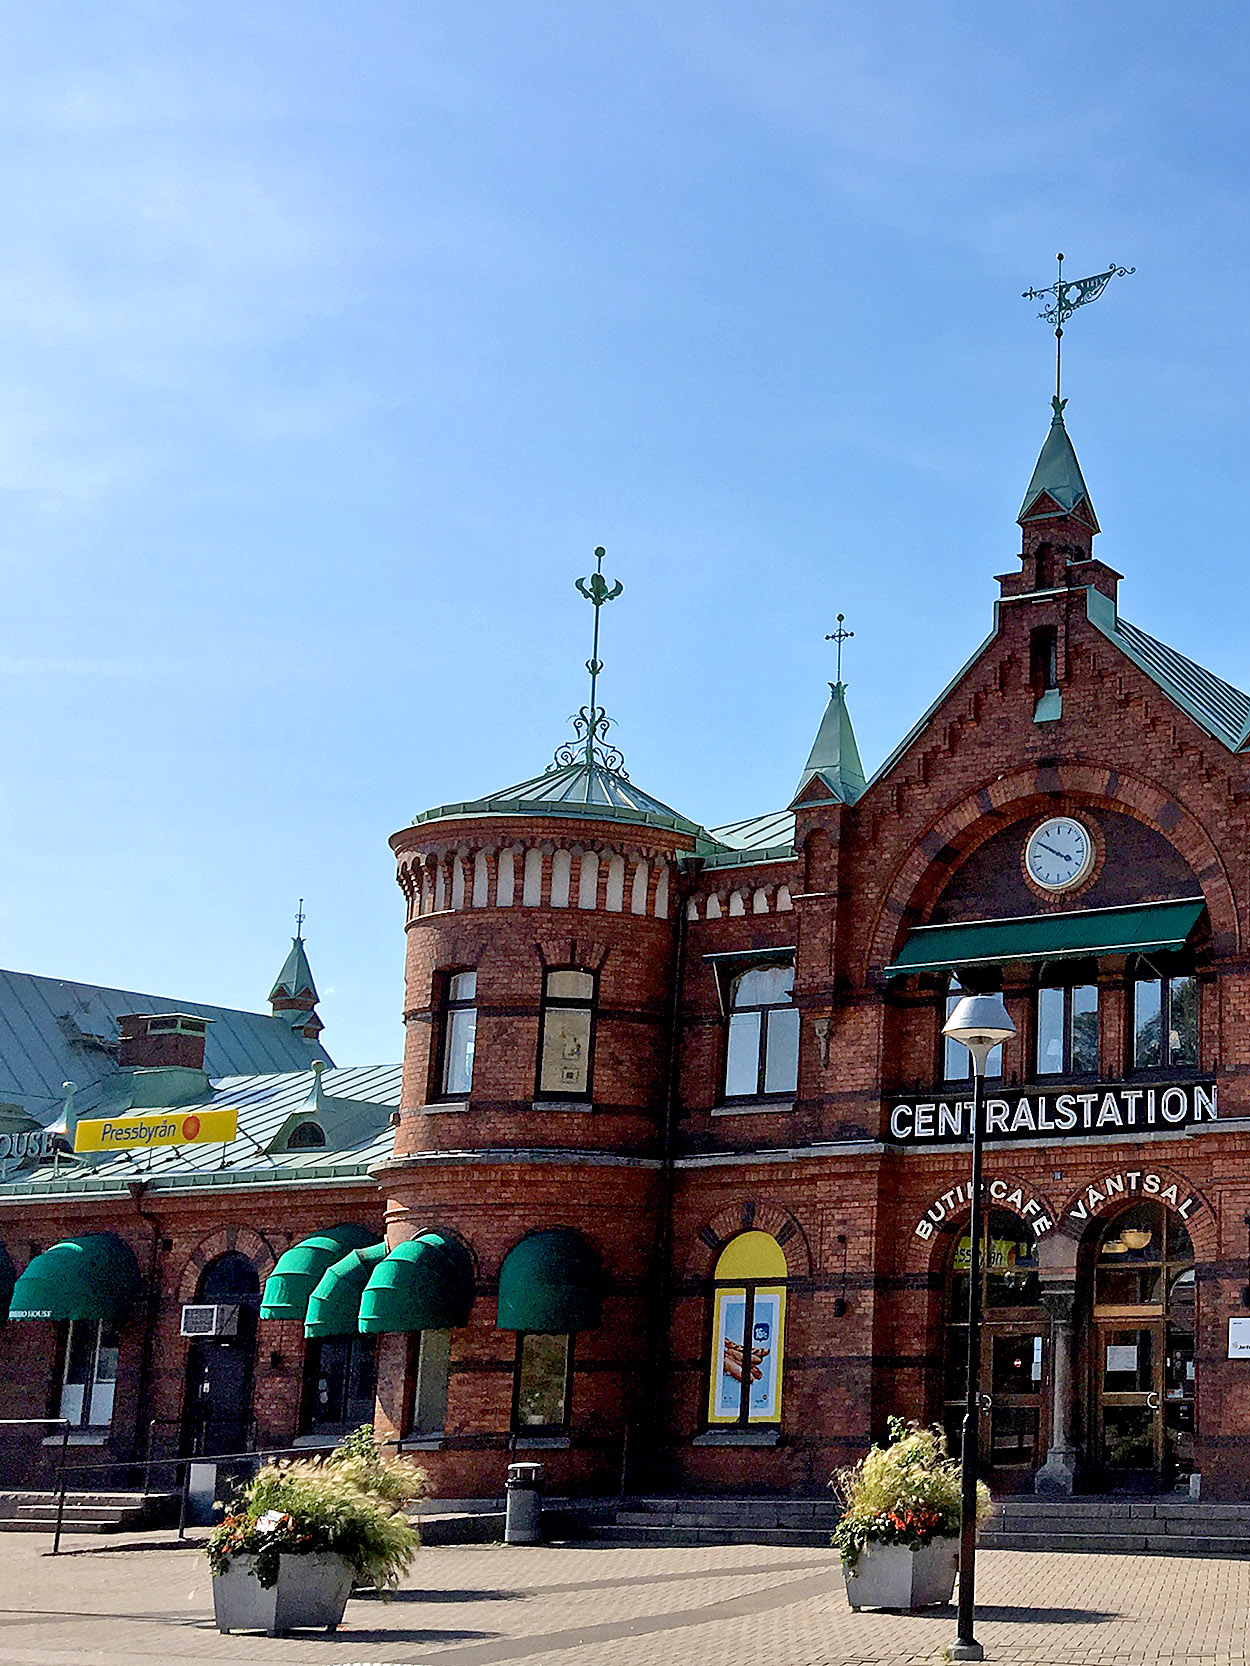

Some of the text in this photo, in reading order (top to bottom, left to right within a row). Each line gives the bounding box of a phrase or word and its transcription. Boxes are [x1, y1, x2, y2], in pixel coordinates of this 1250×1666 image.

[101, 1119, 176, 1143] Pressbyrån
[890, 1085, 1217, 1138] CENTRALSTATION
[989, 1180, 1053, 1237] CAFÉ
[1069, 1171, 1193, 1220] VÄNTSAL
